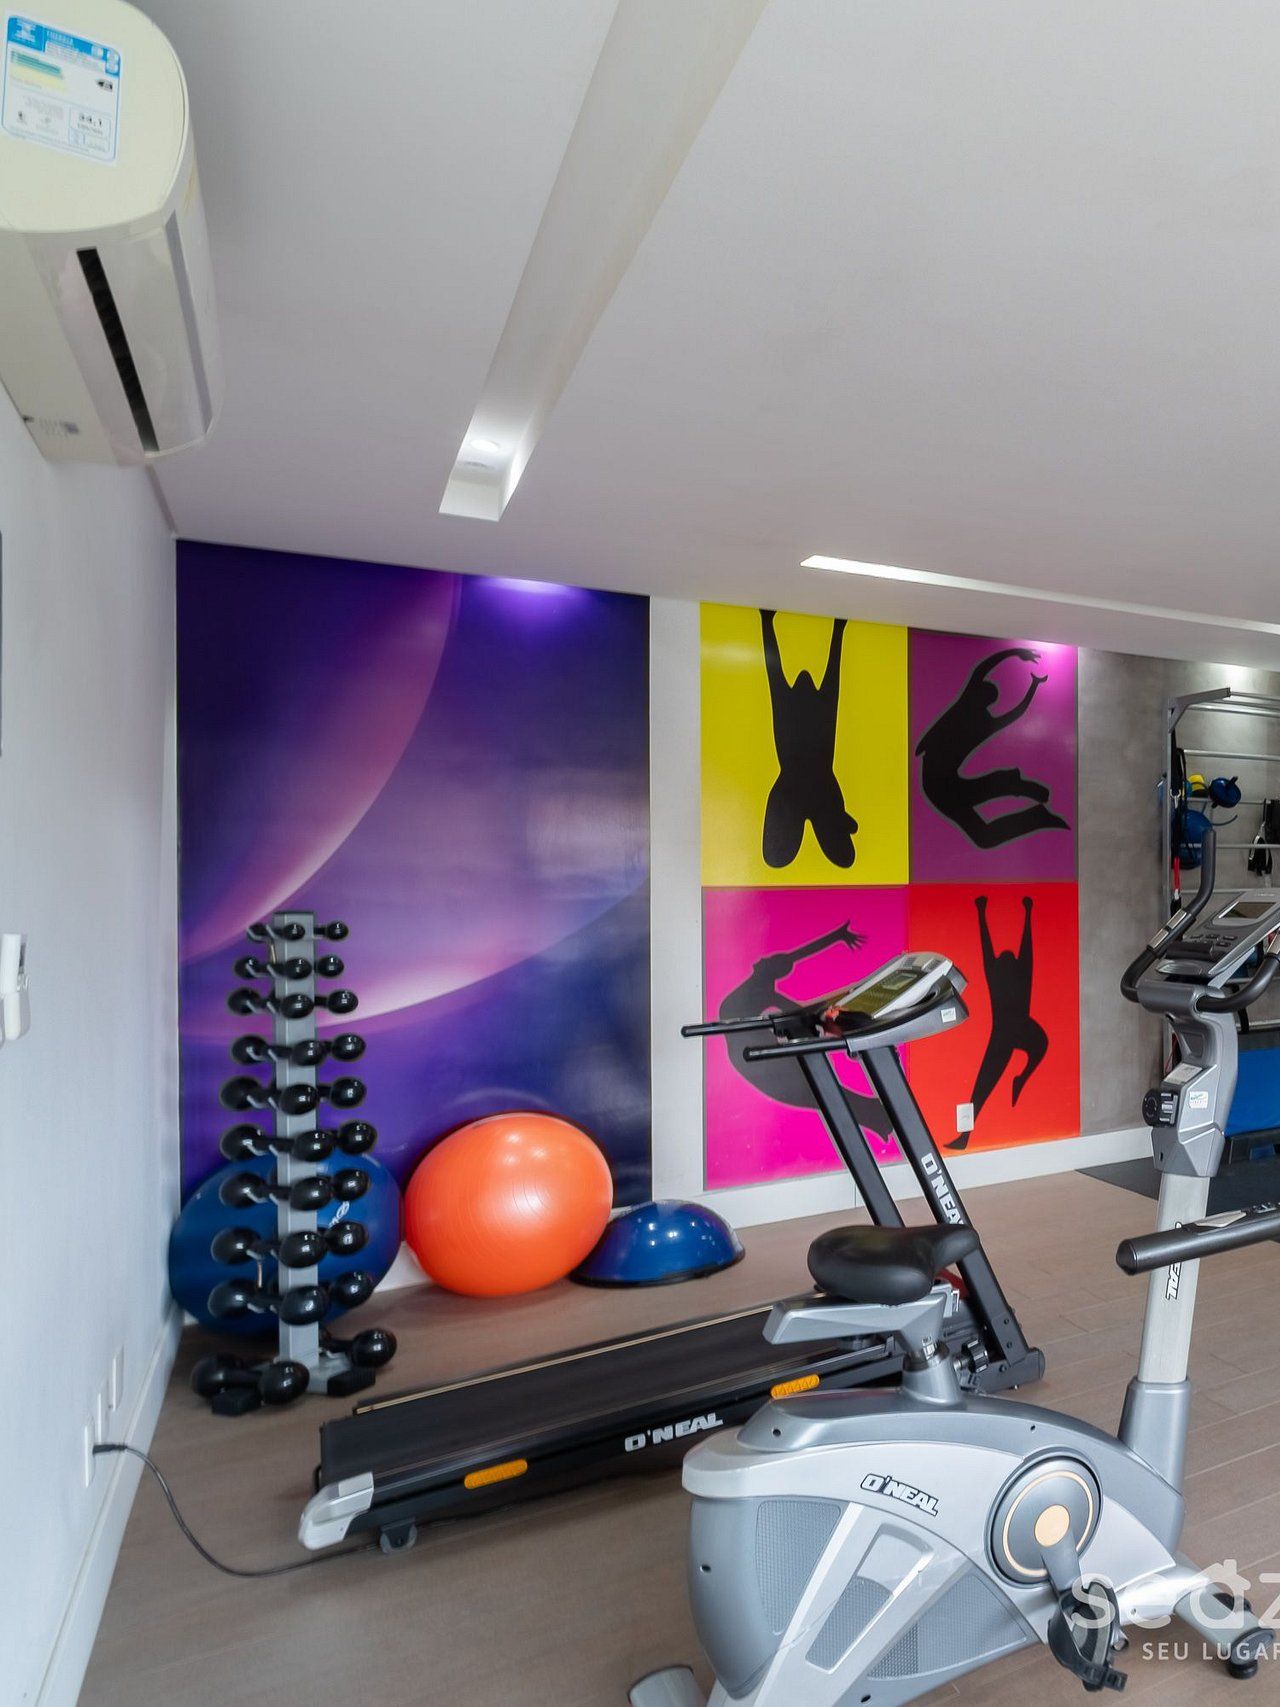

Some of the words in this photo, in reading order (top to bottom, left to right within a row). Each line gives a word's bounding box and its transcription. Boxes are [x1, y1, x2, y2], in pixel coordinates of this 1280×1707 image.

[921, 1152, 964, 1225] O'NEA
[624, 1412, 724, 1453] O'NEAL
[860, 1473, 939, 1517] O'NEAL
